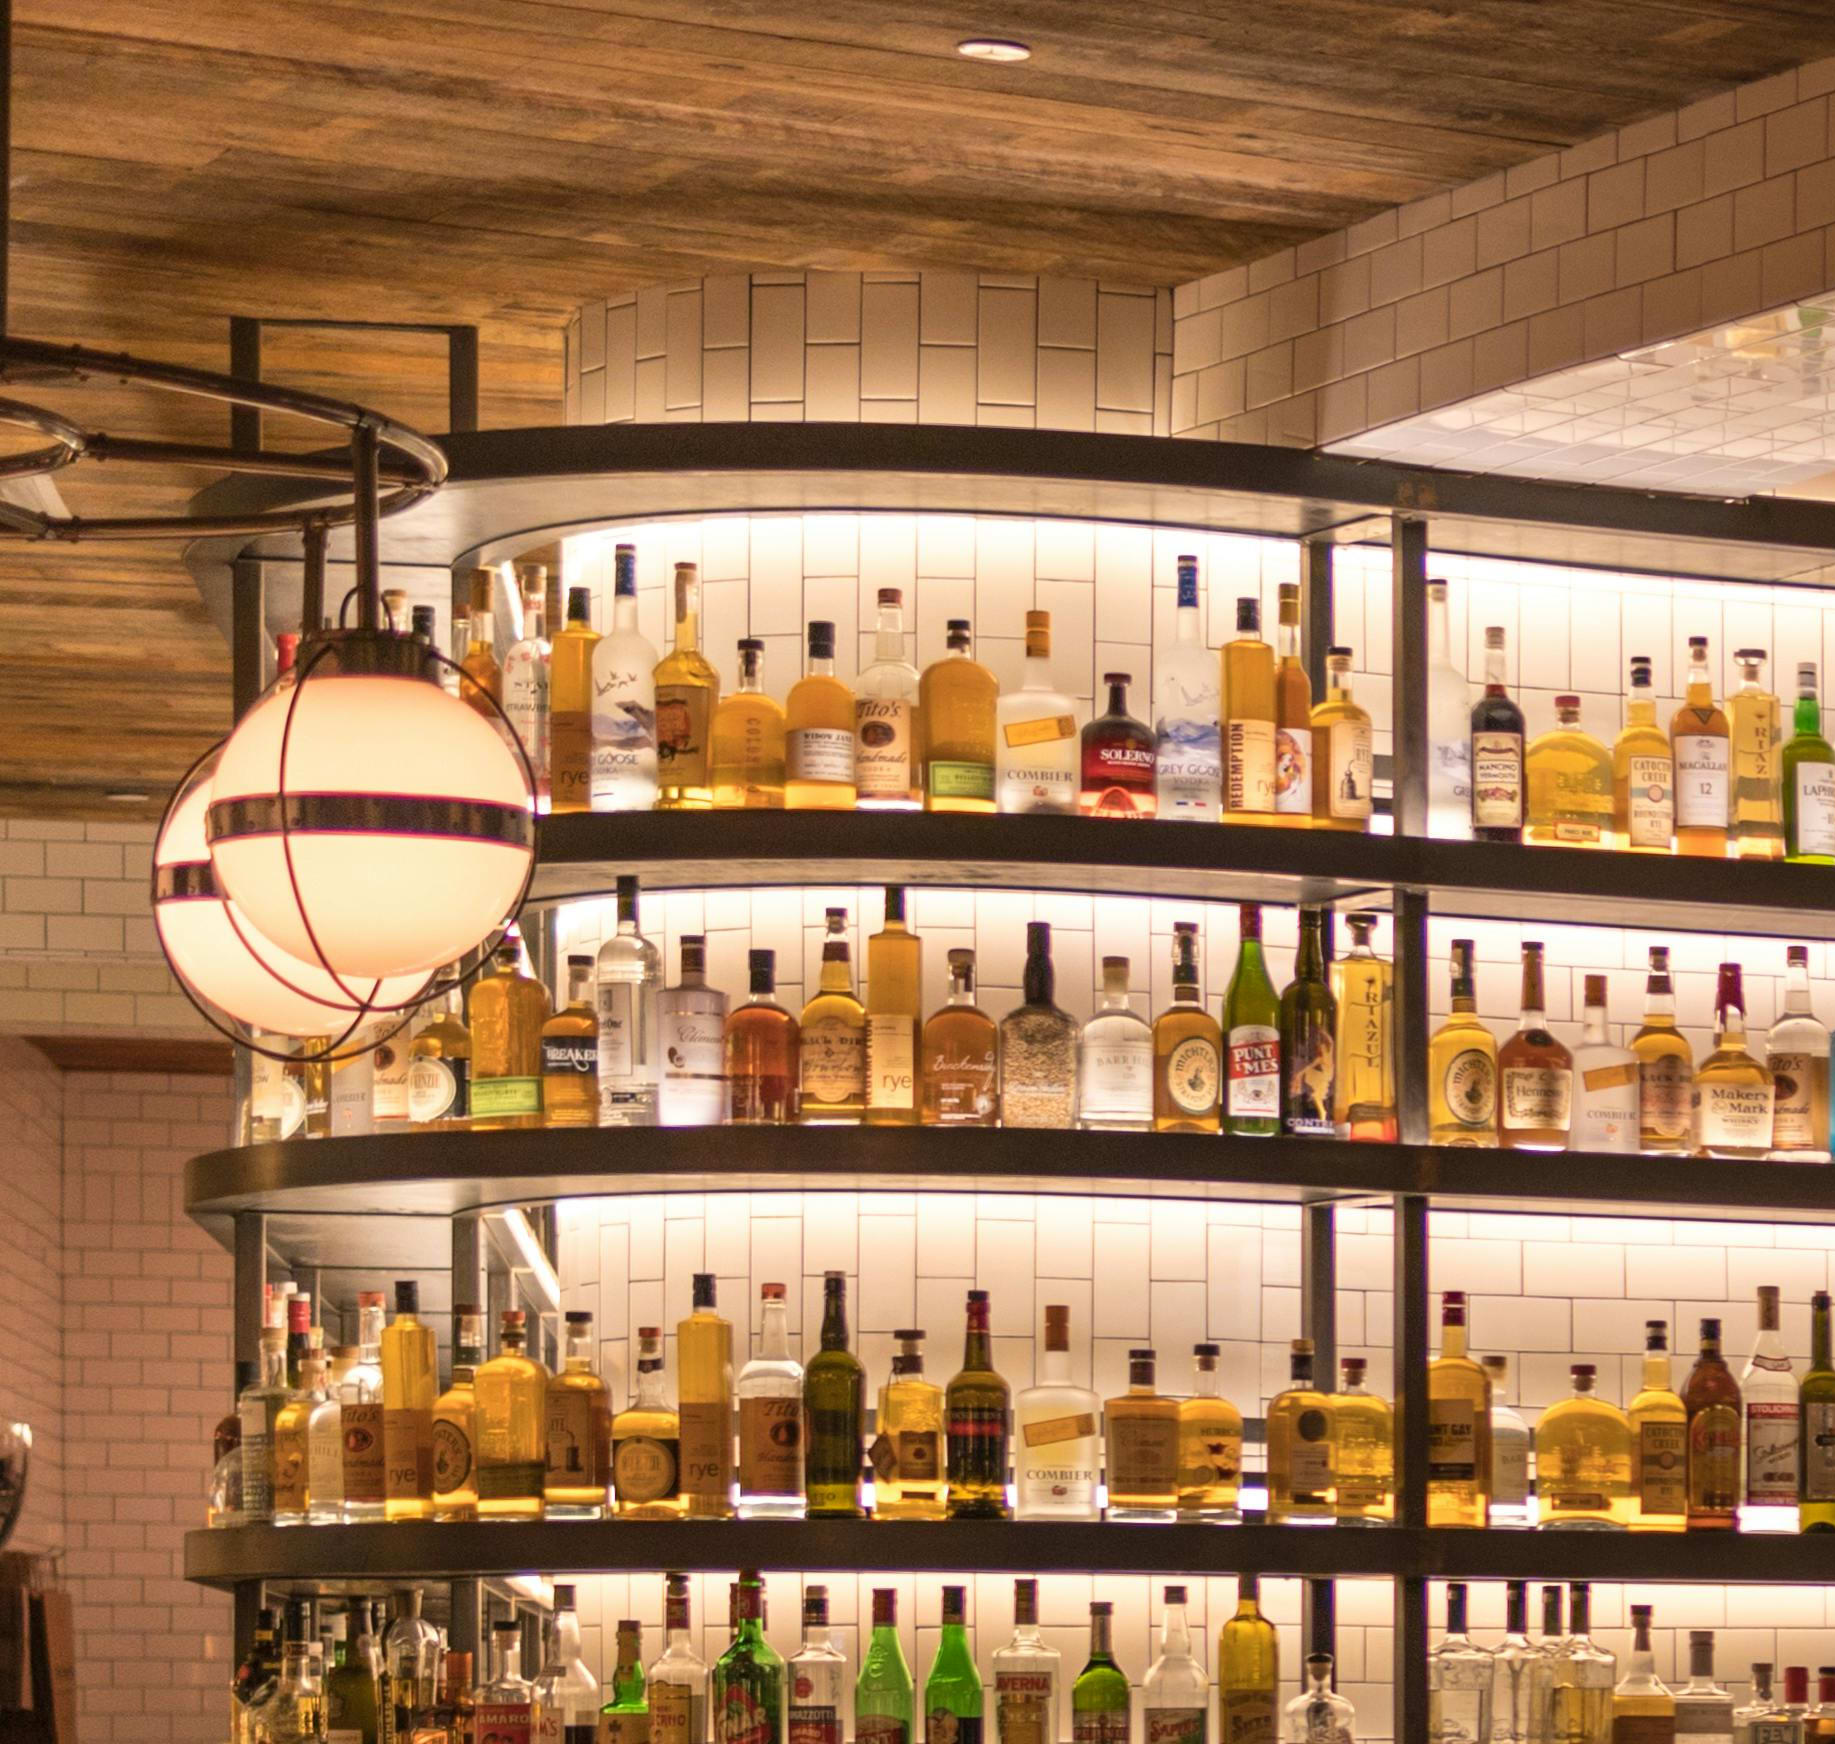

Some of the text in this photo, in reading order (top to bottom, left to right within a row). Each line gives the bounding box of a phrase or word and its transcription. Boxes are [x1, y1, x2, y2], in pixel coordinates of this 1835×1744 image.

[1231, 723, 1244, 808] REDEMPTION
[560, 769, 588, 785] rye
[1007, 768, 1074, 782] COMBIER
[1700, 782, 1712, 795] 12
[1234, 1045, 1274, 1062] PUNT
[883, 1074, 911, 1091] rye
[1712, 1089, 1768, 1101] Maker's
[1730, 1103, 1768, 1115] Mark
[390, 1467, 416, 1485] rye
[689, 1461, 719, 1480] rye
[1027, 1469, 1093, 1481] COMBIER
[997, 1676, 1051, 1691] AVERNA
[479, 1713, 529, 1726] AMARO
